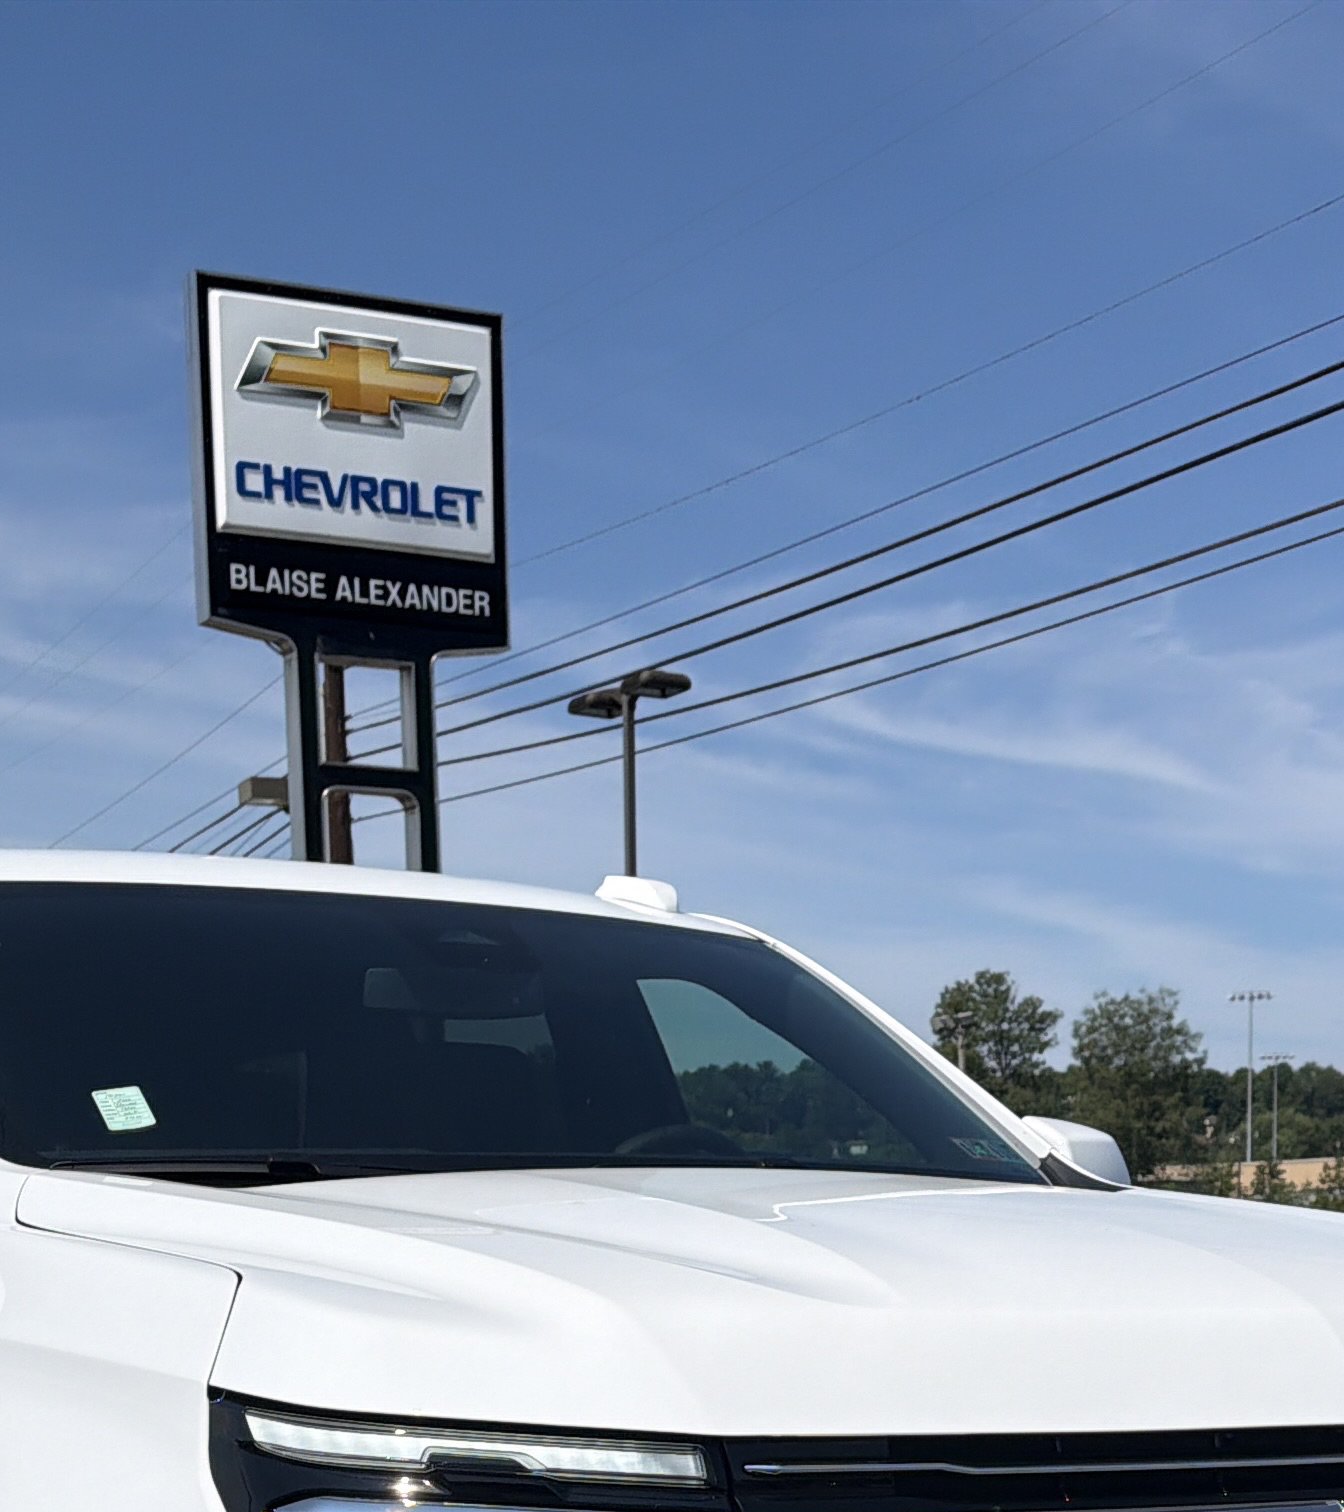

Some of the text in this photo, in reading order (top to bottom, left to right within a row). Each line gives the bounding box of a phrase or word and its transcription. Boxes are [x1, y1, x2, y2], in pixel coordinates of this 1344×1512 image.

[235, 460, 483, 525] CHEVROLET
[229, 562, 491, 617] BLAISE ALEXANDER
